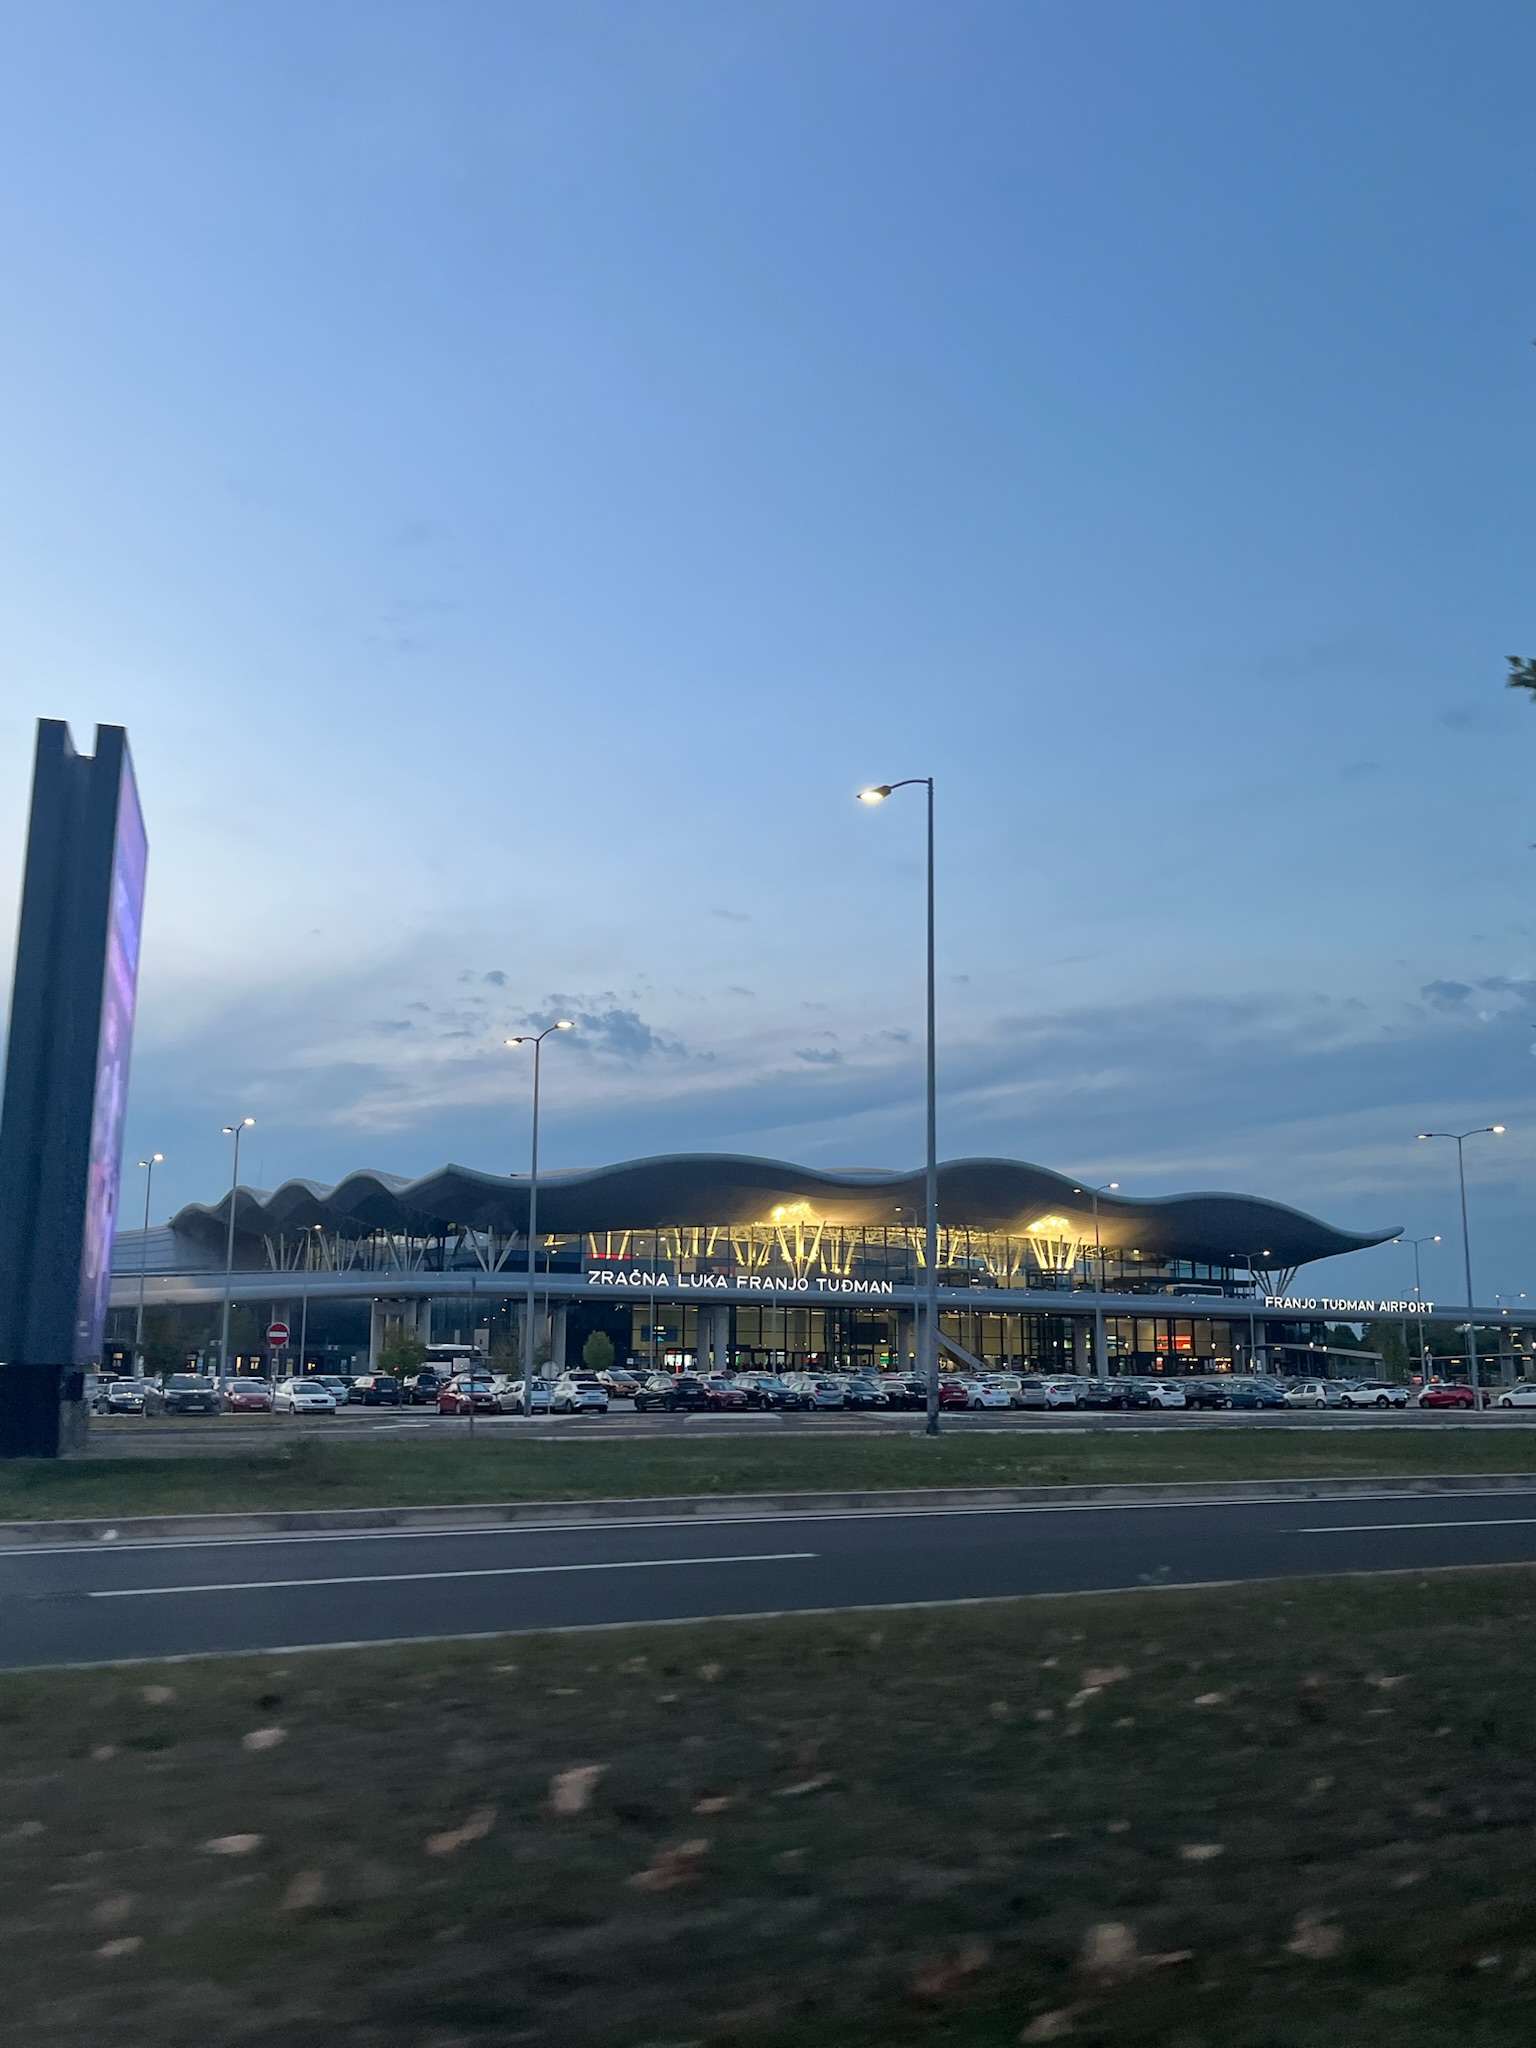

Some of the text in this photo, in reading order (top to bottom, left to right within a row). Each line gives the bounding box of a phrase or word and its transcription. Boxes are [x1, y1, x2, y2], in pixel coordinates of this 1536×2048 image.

[588, 1268, 893, 1294] ZRAČNA LUKA FRANJO TUĐMAN
[1265, 1296, 1434, 1314] FRANJO TUĐMAN AIRPORT
